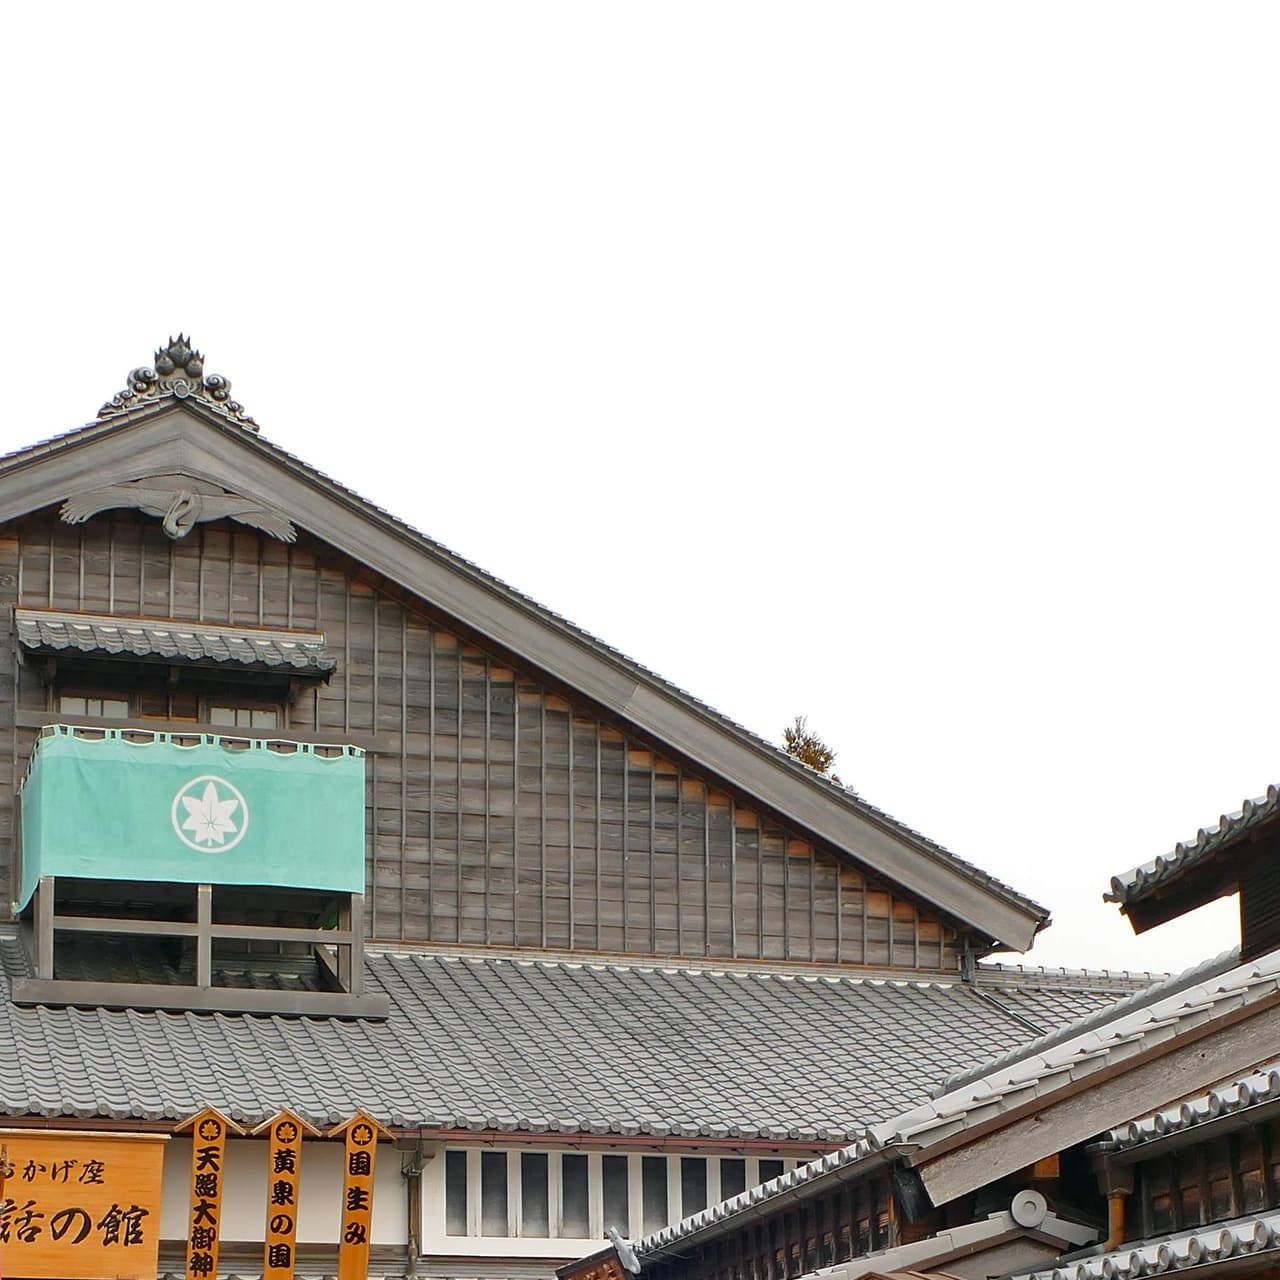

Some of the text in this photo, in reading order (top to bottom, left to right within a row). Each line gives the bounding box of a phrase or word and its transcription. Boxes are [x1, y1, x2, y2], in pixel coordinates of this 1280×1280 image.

[189, 1145, 221, 1278] 天照大御神
